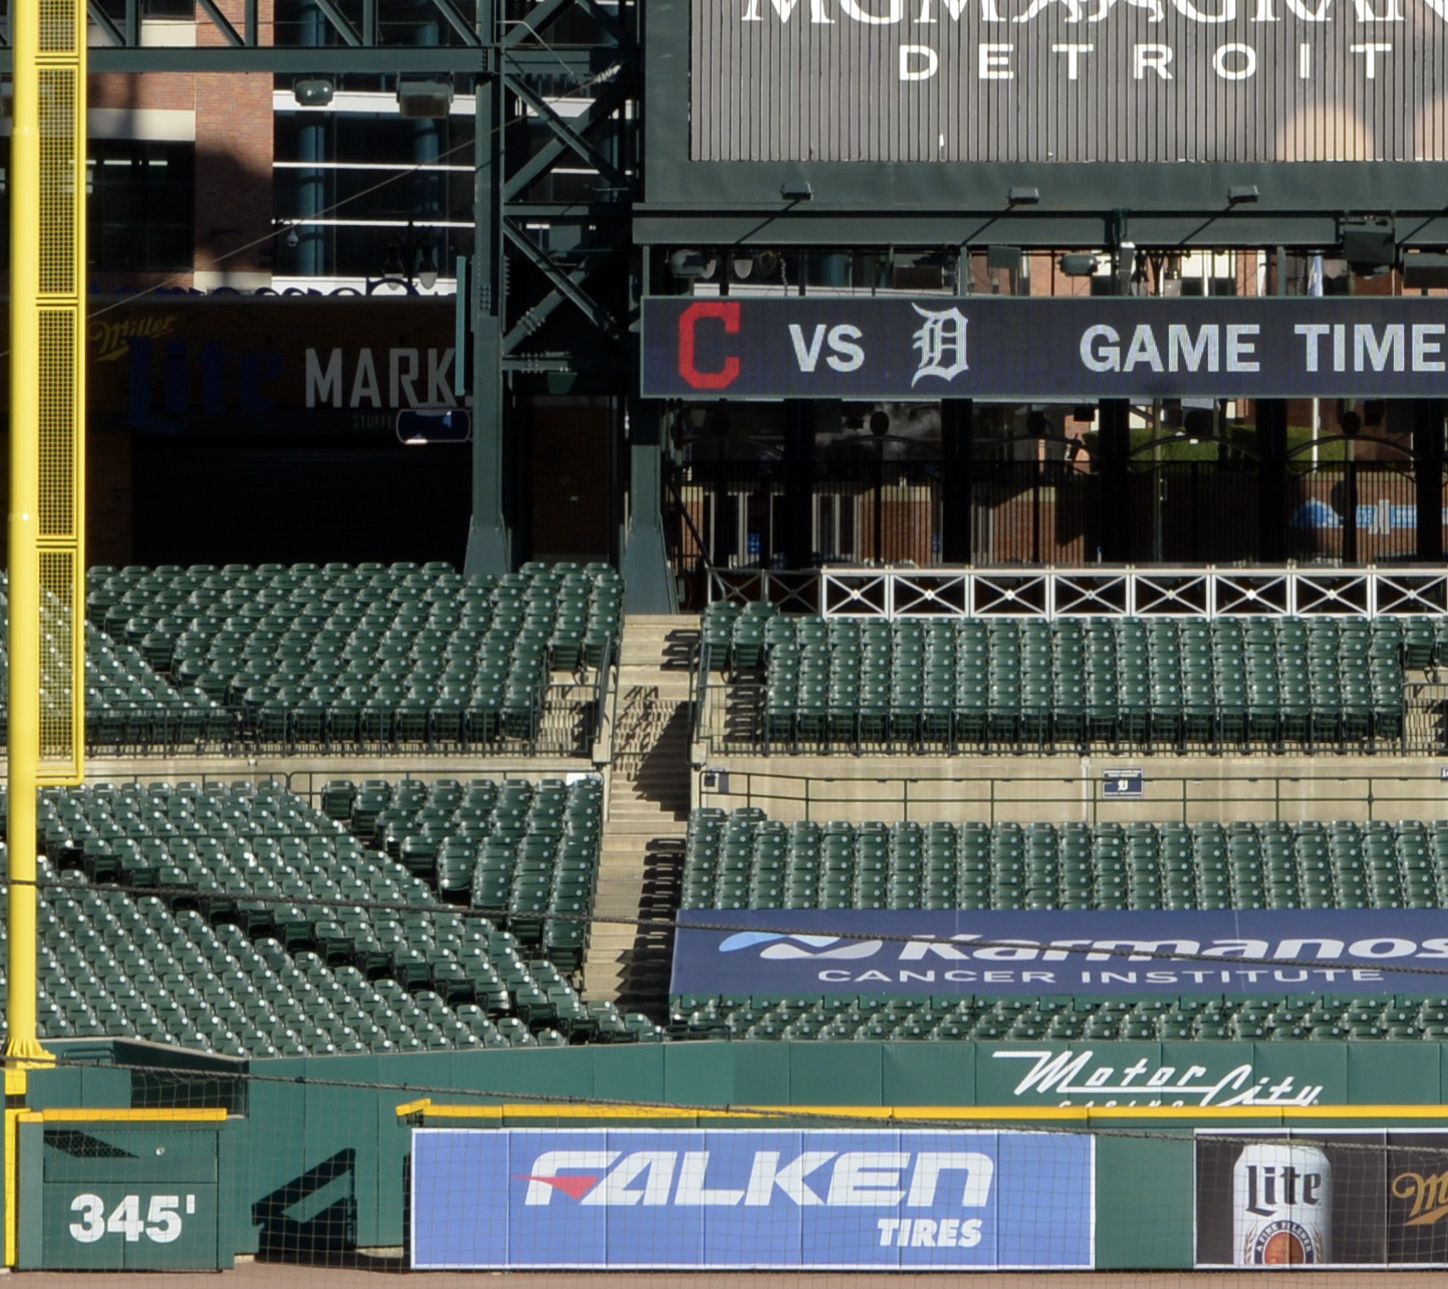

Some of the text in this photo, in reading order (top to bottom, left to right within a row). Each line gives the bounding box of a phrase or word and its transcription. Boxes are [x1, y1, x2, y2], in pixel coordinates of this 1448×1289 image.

[899, 42, 1393, 82] DETROIT
[87, 315, 178, 363] Miller
[788, 323, 865, 374] VS
[1078, 322, 1260, 374] GAME
[817, 968, 1384, 984] CANCER INSTITUTE
[524, 1151, 995, 1207] FALKEN
[1245, 1164, 1322, 1218] Lite
[69, 1194, 196, 1243] 345'
[877, 1218, 983, 1248] TIRES
[1258, 1220, 1312, 1252] FINE PILSNER
